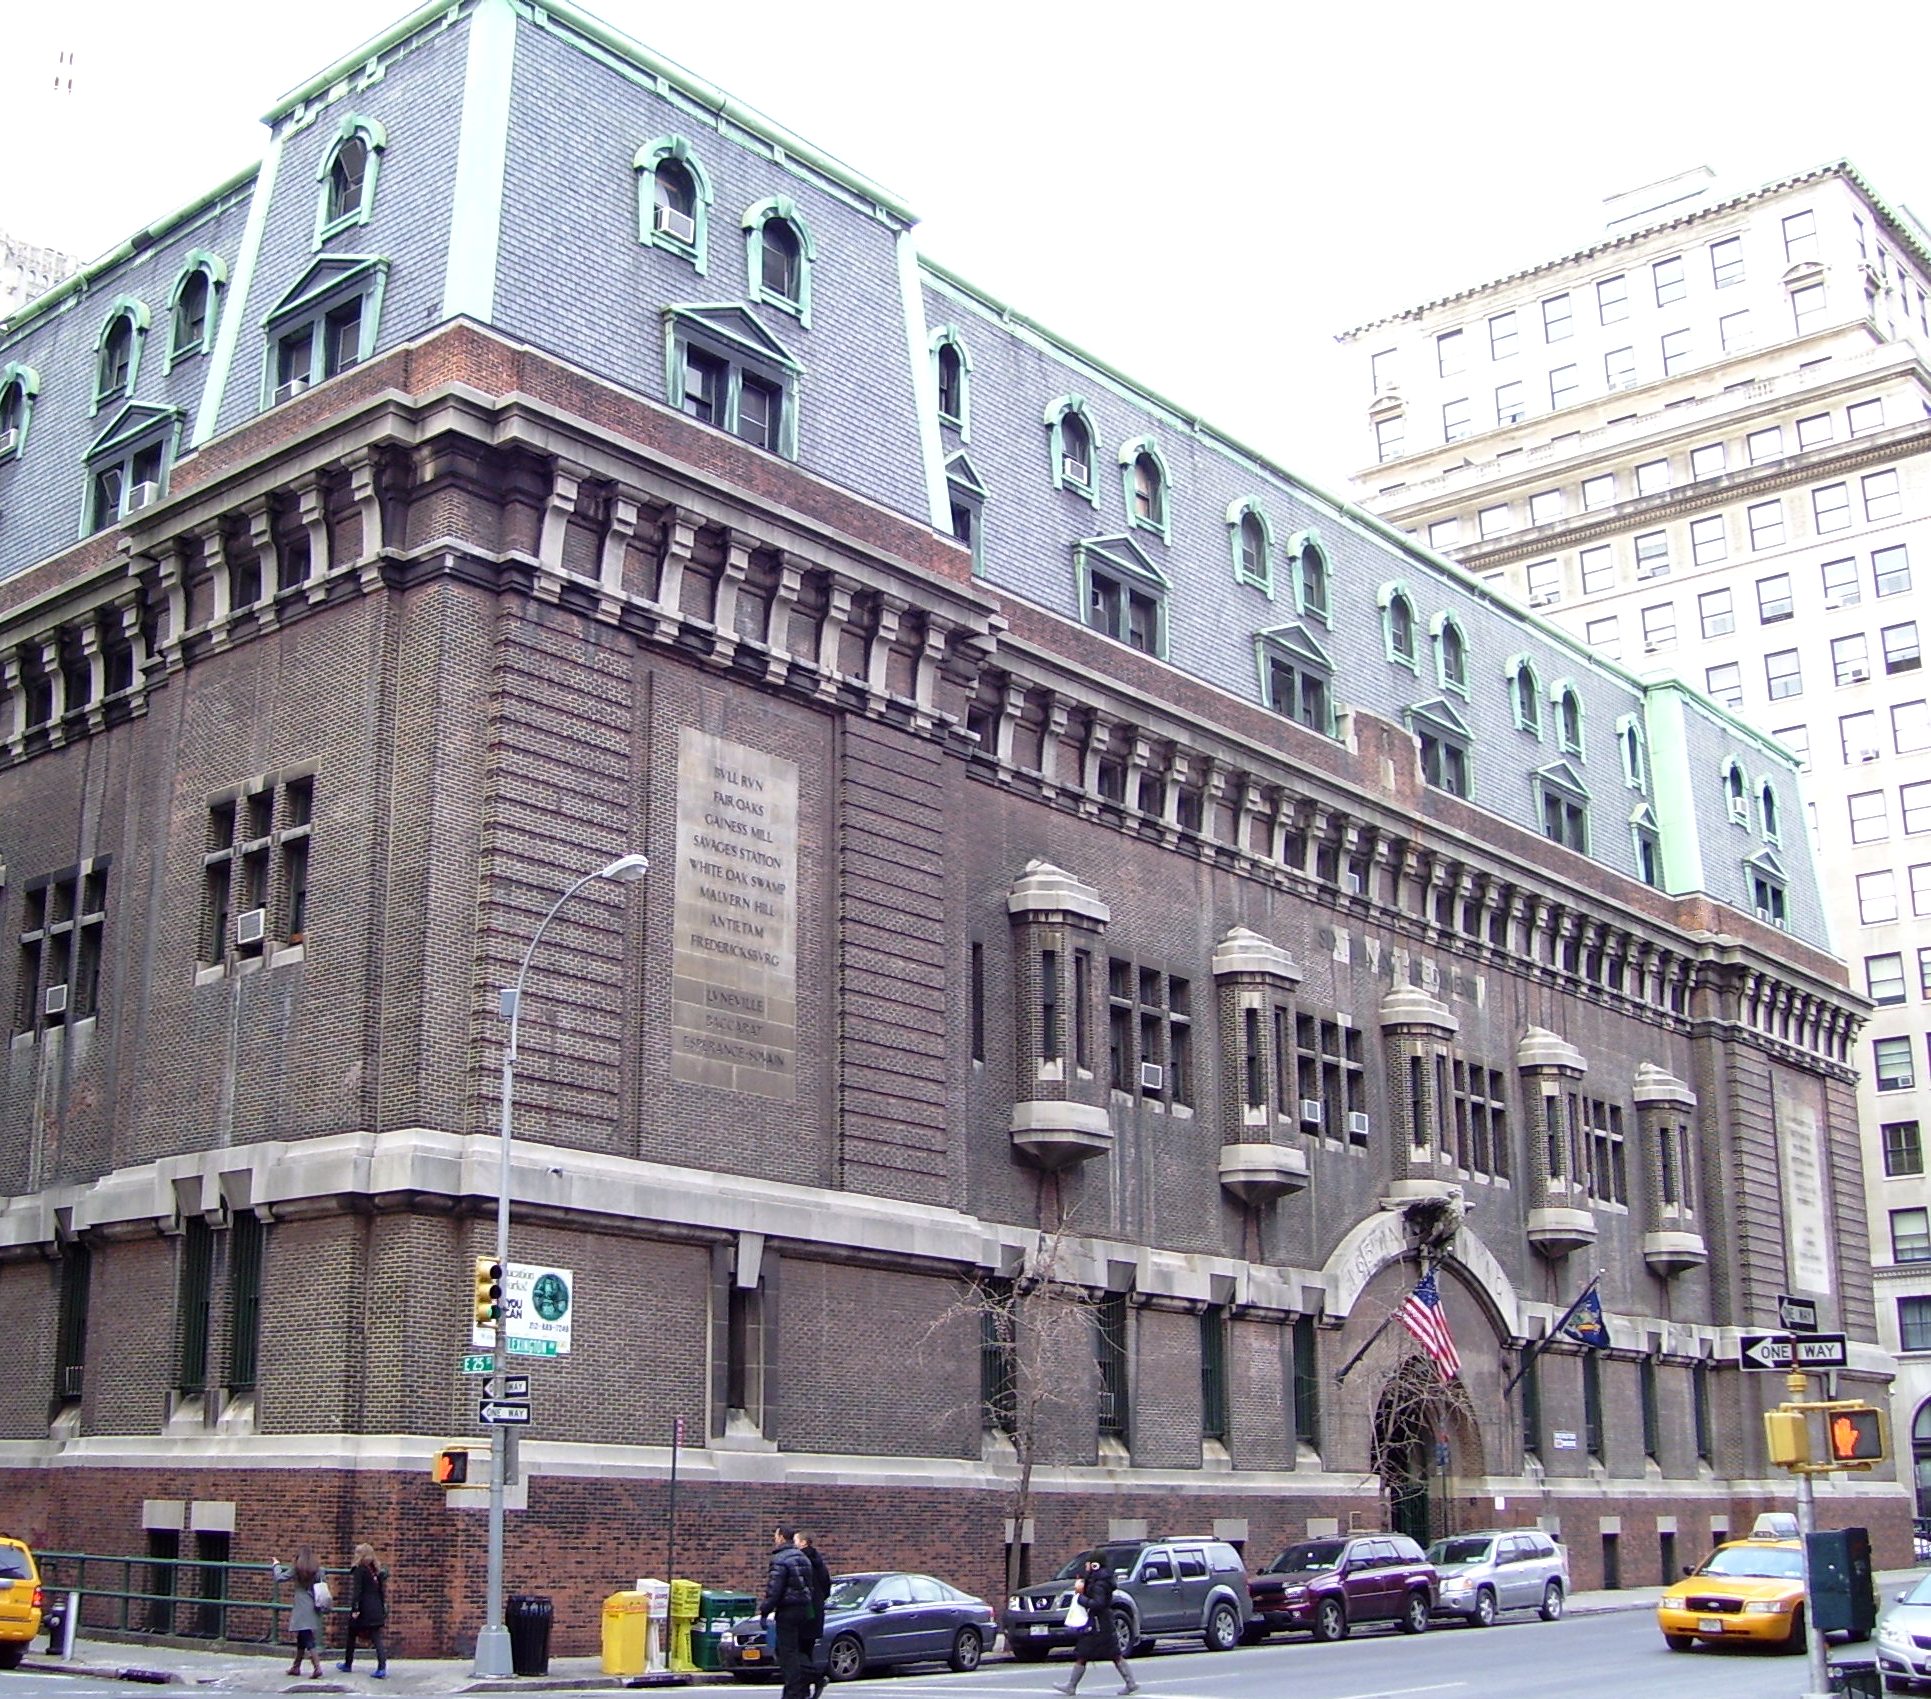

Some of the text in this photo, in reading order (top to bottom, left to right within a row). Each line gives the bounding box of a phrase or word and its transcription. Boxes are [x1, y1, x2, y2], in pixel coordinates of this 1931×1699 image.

[741, 776, 763, 791] RVN
[714, 791, 763, 816] FAIR OAKS
[751, 827, 773, 843] MILL
[740, 847, 781, 868] STATION
[689, 858, 786, 895] WHITE OAK SWAMP
[700, 886, 775, 917] MALVERN HILL
[710, 914, 764, 938] ANTIETAM
[506, 1299, 523, 1309] YOU
[1761, 1344, 1835, 1359] ONE WAY
[464, 1357, 471, 1372] E
[472, 1357, 485, 1371] 25
[486, 1407, 524, 1417] ONE WAY
